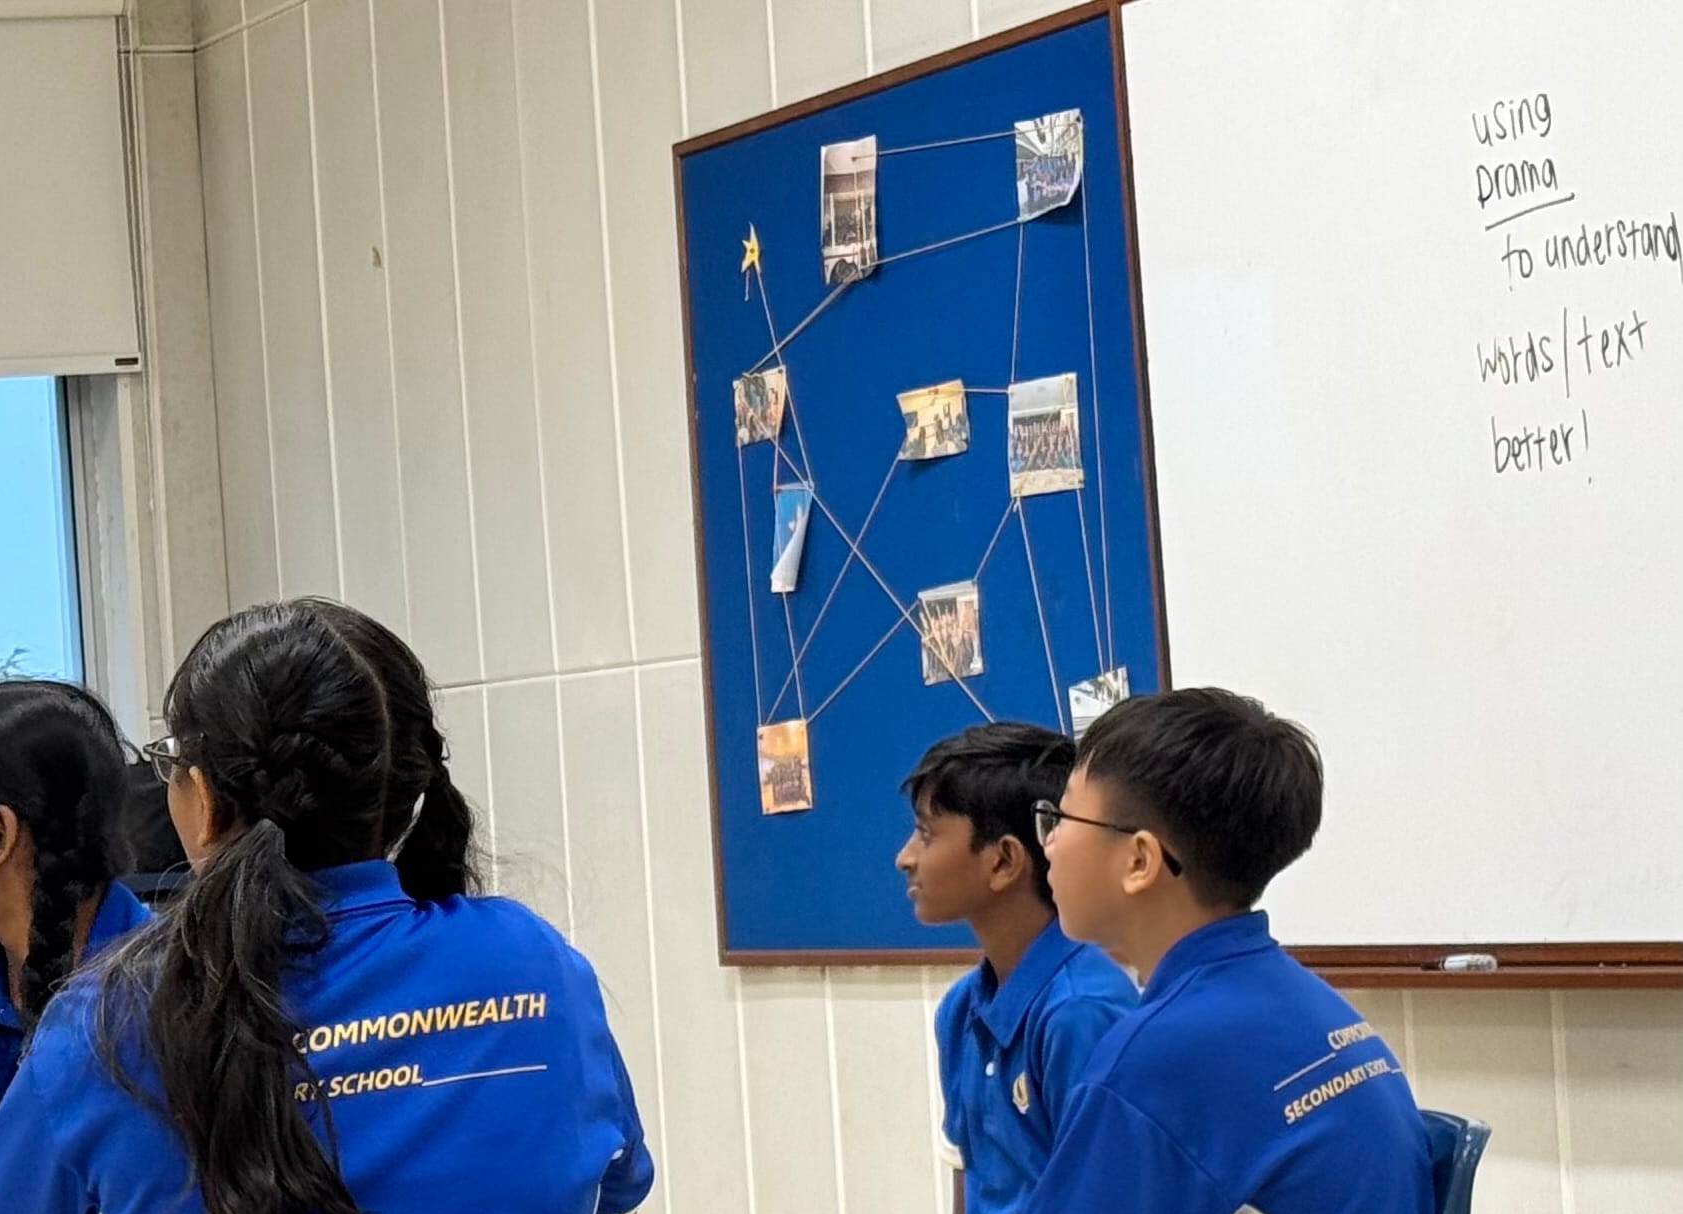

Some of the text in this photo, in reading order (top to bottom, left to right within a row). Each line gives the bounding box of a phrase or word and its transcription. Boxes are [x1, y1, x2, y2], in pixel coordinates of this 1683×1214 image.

[1472, 93, 1552, 147] using
[1501, 211, 1683, 292] to understand
[1490, 408, 1593, 486] better!
[327, 1063, 424, 1098] SCHOOL
[1283, 1065, 1368, 1126] SECONDARY
